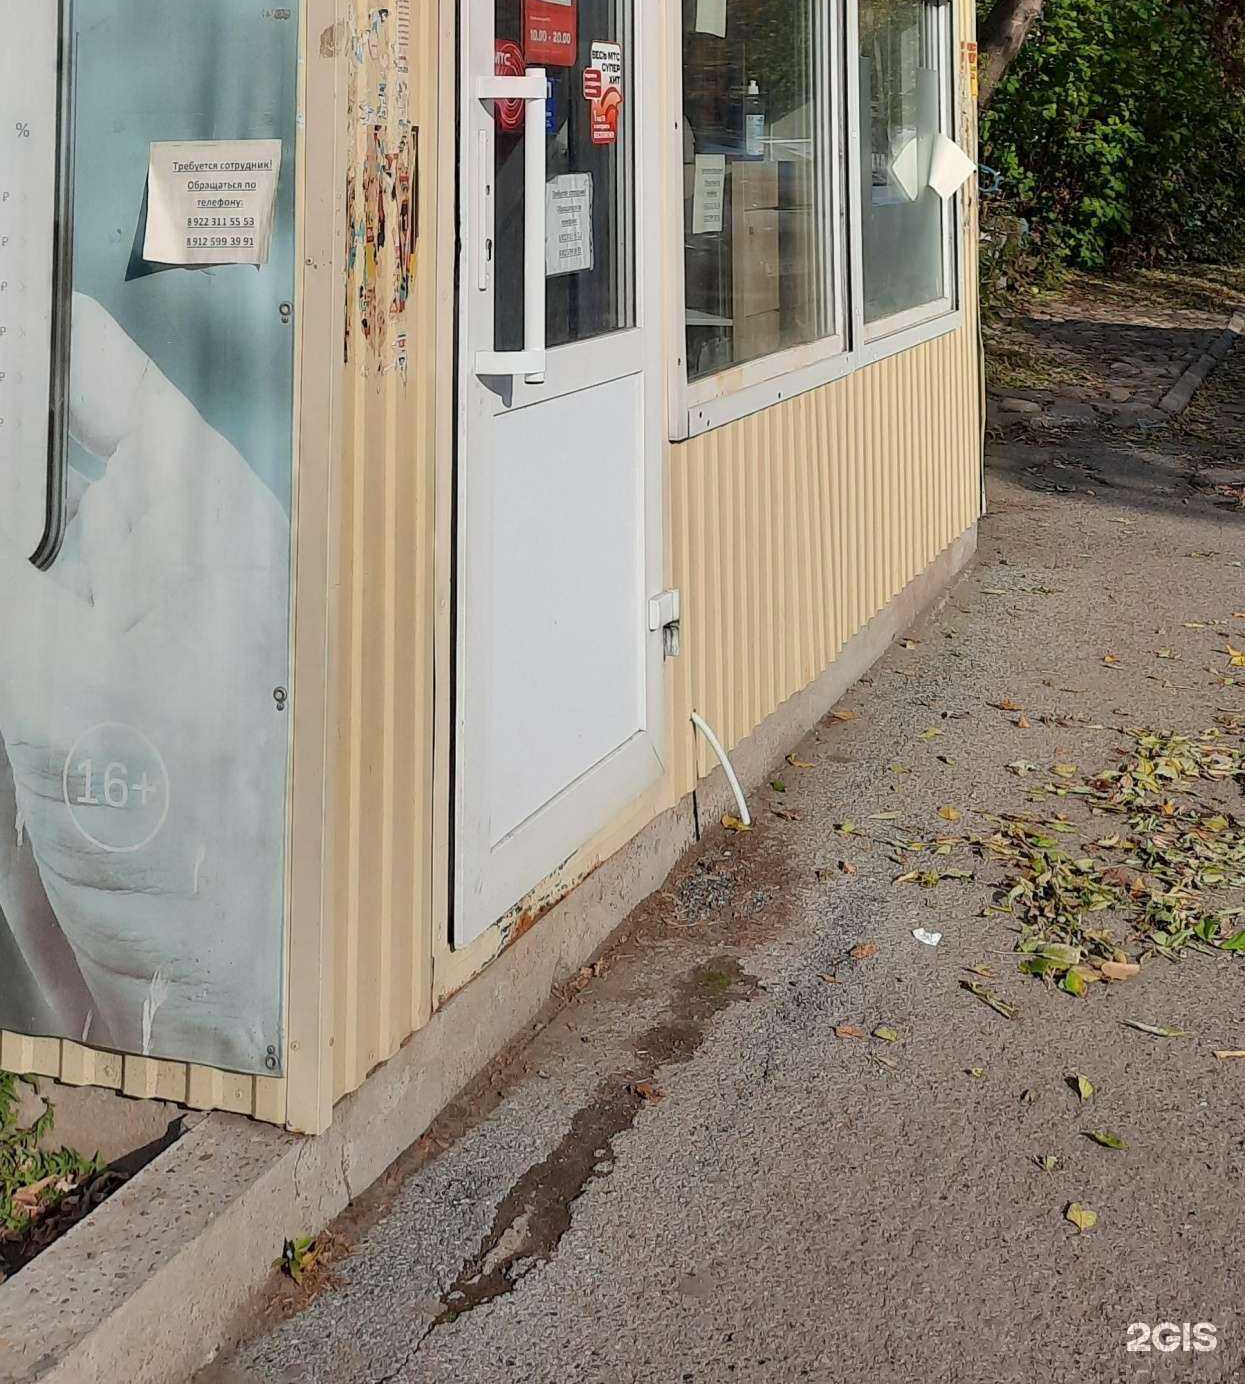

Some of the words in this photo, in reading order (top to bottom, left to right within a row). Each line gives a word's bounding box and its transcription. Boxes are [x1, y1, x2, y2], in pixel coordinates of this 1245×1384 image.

[552, 31, 571, 44] 20.00
[602, 63, 620, 73] СУПЕР
[15, 122, 30, 138] %
[172, 161, 218, 172] Требуется
[220, 160, 272, 171] сотрудник!
[187, 181, 242, 191] Обращаться
[244, 182, 256, 191] по
[193, 217, 209, 226] 922
[211, 217, 226, 226] 311
[230, 217, 241, 226] 55
[244, 217, 255, 226] 53
[192, 237, 208, 246] 912
[211, 237, 227, 246] 599
[230, 237, 241, 246] 39
[244, 237, 254, 246] 91
[77, 759, 157, 808] 16+
